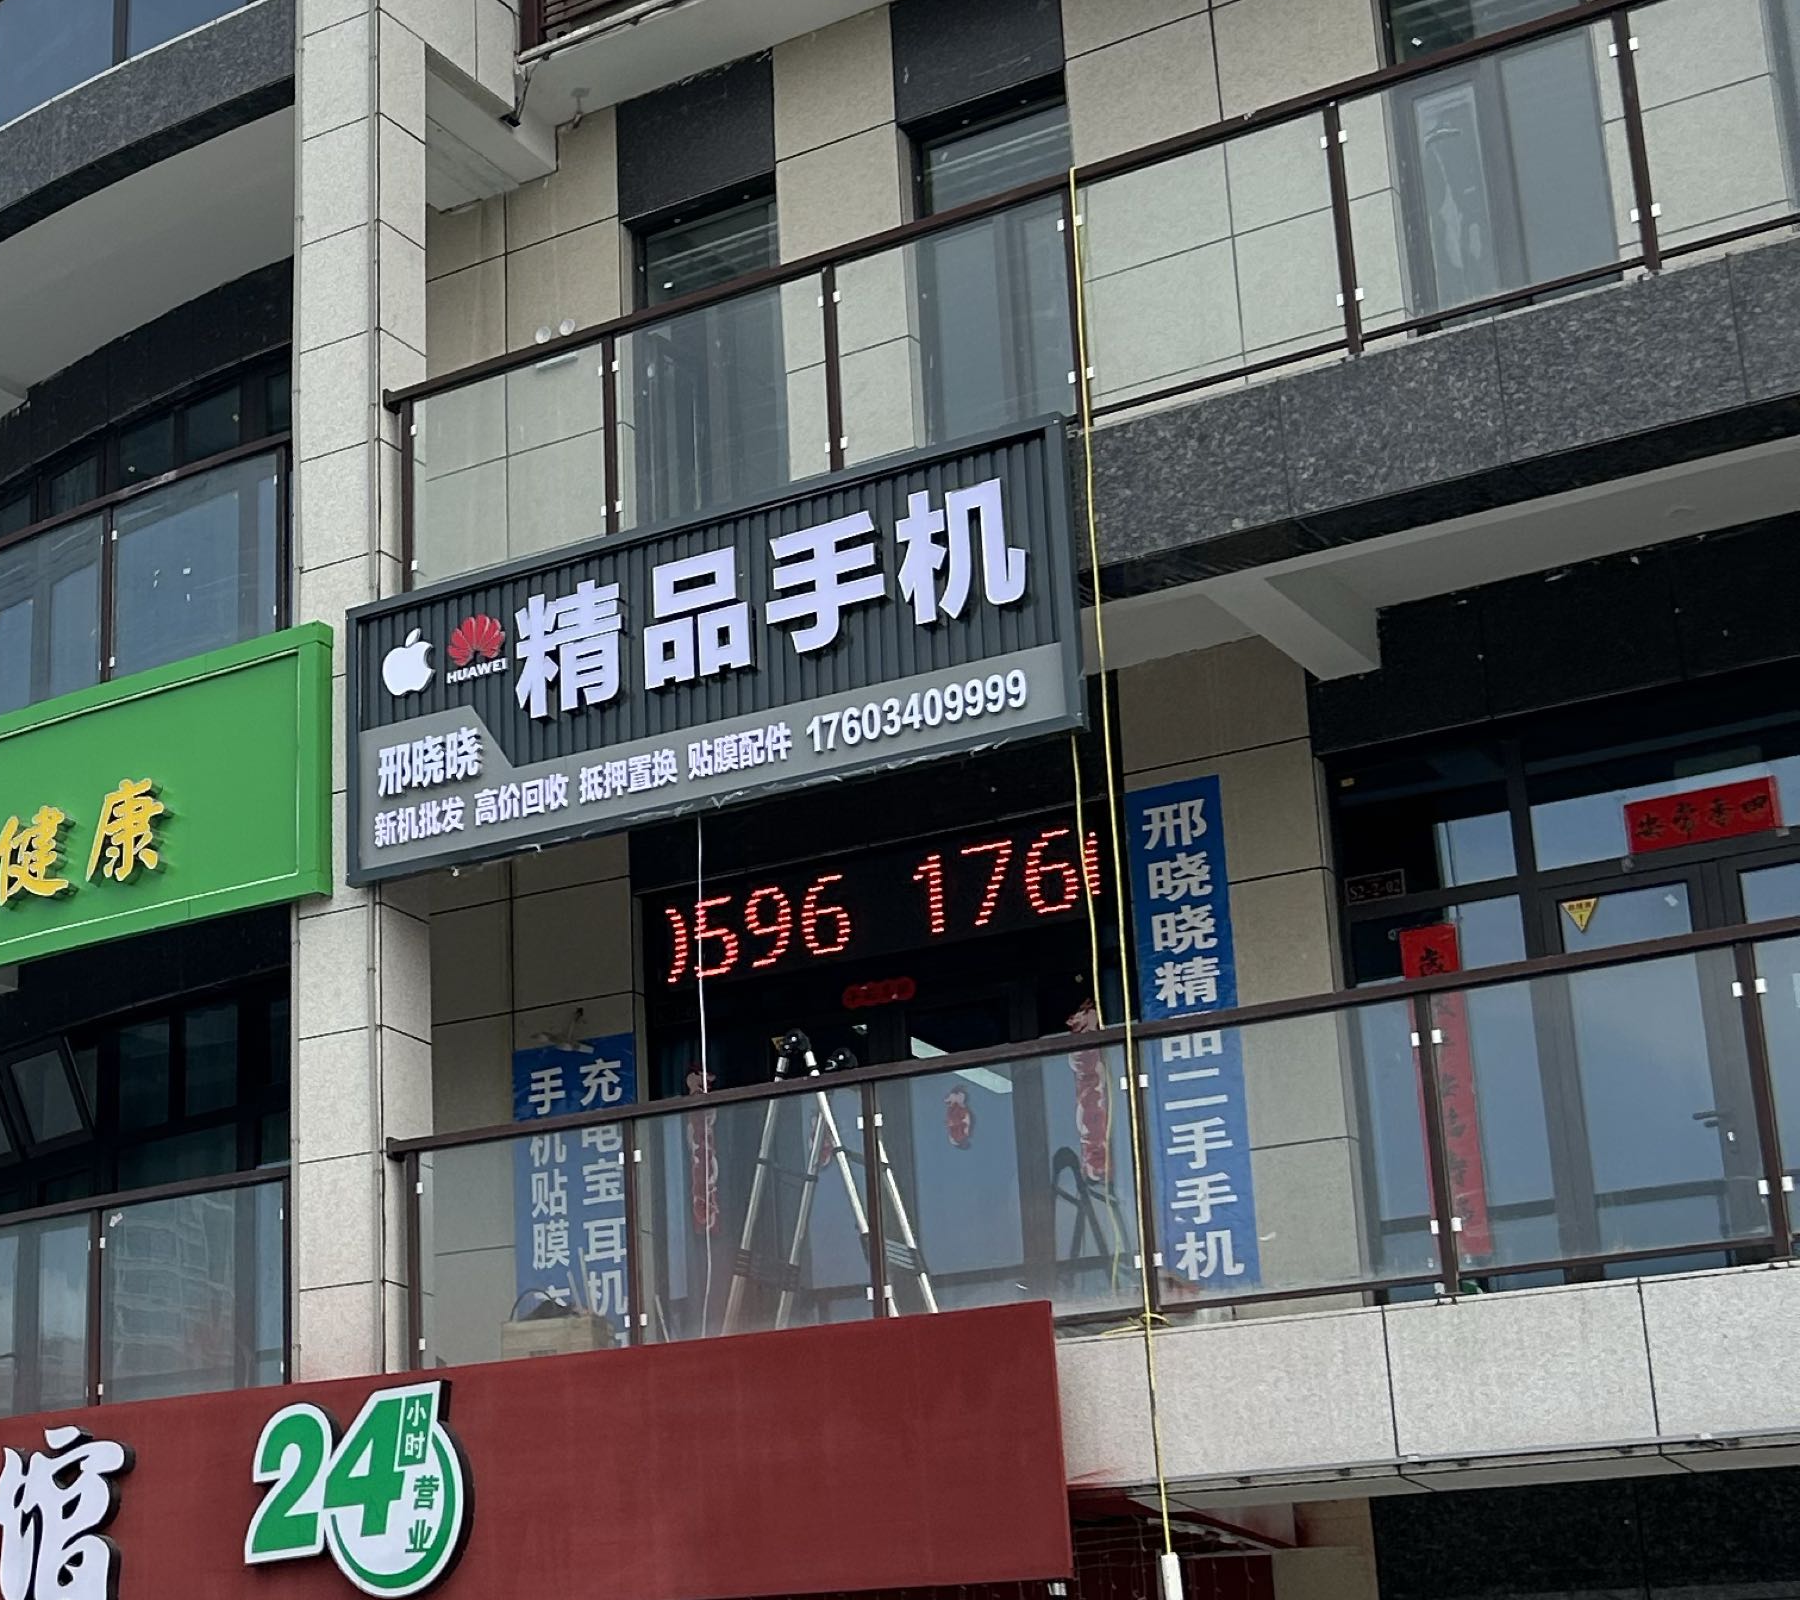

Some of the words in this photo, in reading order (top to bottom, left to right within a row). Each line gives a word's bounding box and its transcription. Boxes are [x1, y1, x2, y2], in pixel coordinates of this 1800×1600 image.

[446, 657, 509, 684] HUAWEI
[515, 479, 1026, 720] 精品手机
[373, 796, 466, 849] 新机批发
[473, 773, 570, 826] 高价回收
[578, 749, 679, 805] 抵押置换
[687, 721, 793, 782] 贴膜配件
[805, 668, 1028, 753] 17603409999
[377, 726, 484, 797] 邢晓晓
[1141, 797, 1246, 1282] 邢晓晓精品二手手机
[249, 1394, 407, 1556] 24
